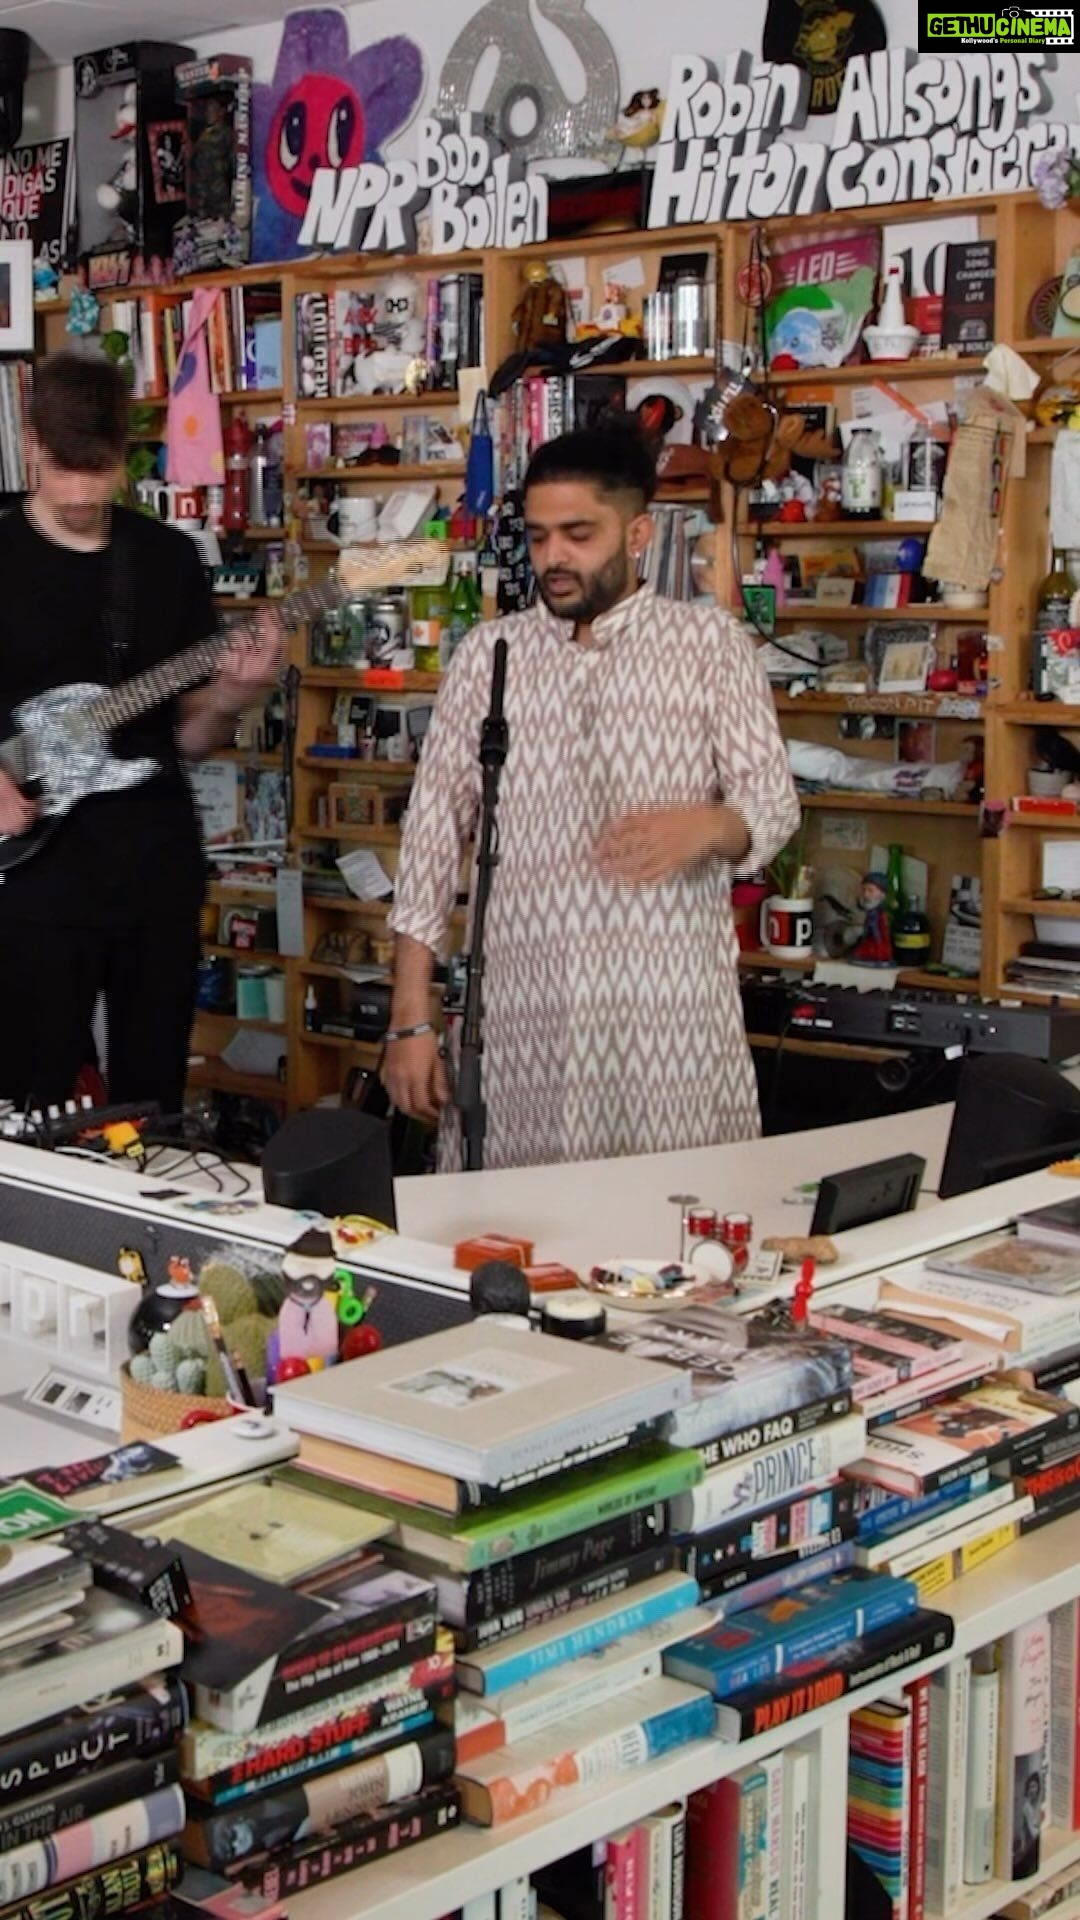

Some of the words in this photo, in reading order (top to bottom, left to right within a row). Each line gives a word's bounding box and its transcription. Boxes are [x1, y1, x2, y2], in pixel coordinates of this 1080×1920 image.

[660, 50, 802, 144] Robin
[831, 48, 1048, 150] Allsongs
[5, 150, 33, 174] NO
[38, 142, 63, 169] ME
[418, 112, 488, 188] Bob
[647, 129, 826, 229] Hilton
[2, 197, 40, 222] QUE
[4, 168, 57, 199] DIGAS
[297, 162, 419, 250] NPR
[432, 153, 549, 254] Boilen
[701, 1443, 721, 1465] HE
[721, 1428, 761, 1457] WHO
[763, 1416, 793, 1443] FAQ
[753, 1438, 816, 1503] PRINCE
[582, 1535, 614, 1561] Page
[571, 1608, 645, 1648] HENDRIX
[755, 1697, 790, 1734] PLAY
[791, 1687, 805, 1721] IT
[808, 1672, 844, 1714] LOUD
[245, 1738, 305, 1777] HARD
[310, 1707, 371, 1751] STUFF
[58, 1804, 85, 1826] AIR
